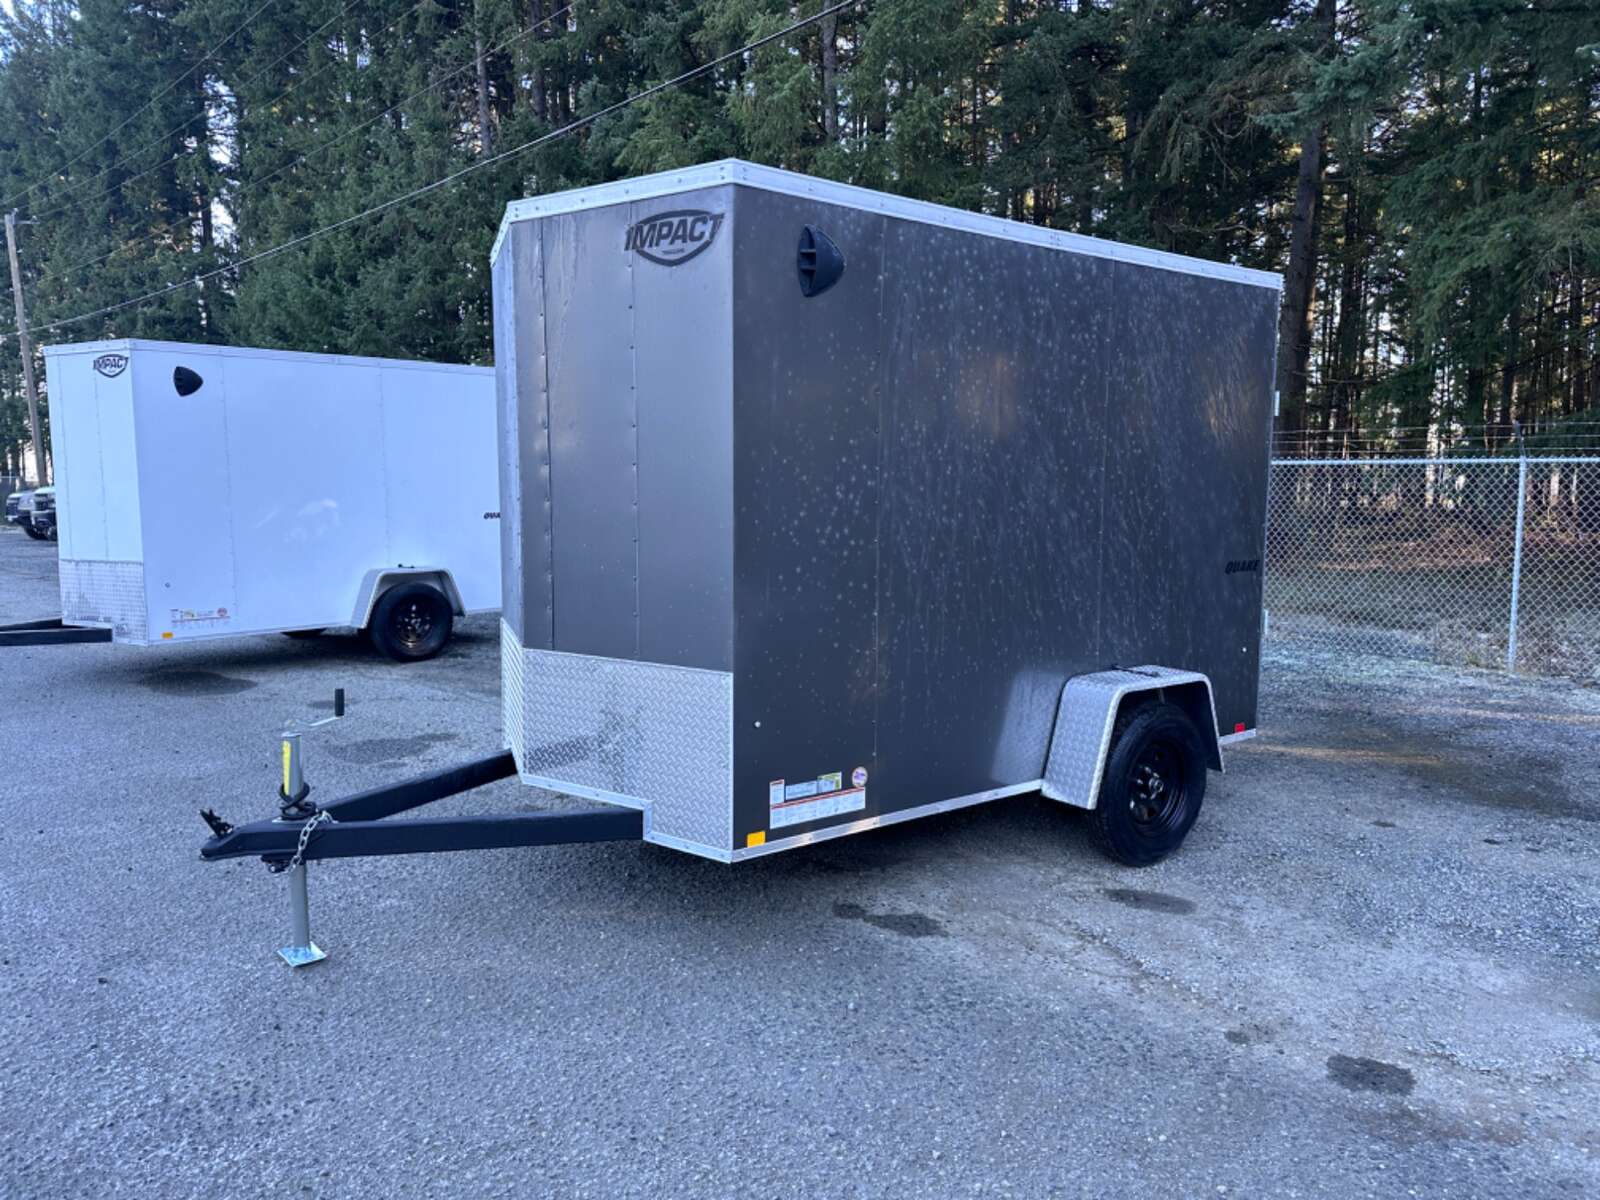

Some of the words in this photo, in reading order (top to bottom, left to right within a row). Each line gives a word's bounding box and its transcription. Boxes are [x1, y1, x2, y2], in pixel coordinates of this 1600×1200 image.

[624, 213, 725, 251] IMPACT
[93, 357, 129, 370] IMPACT
[483, 511, 501, 520] QUA
